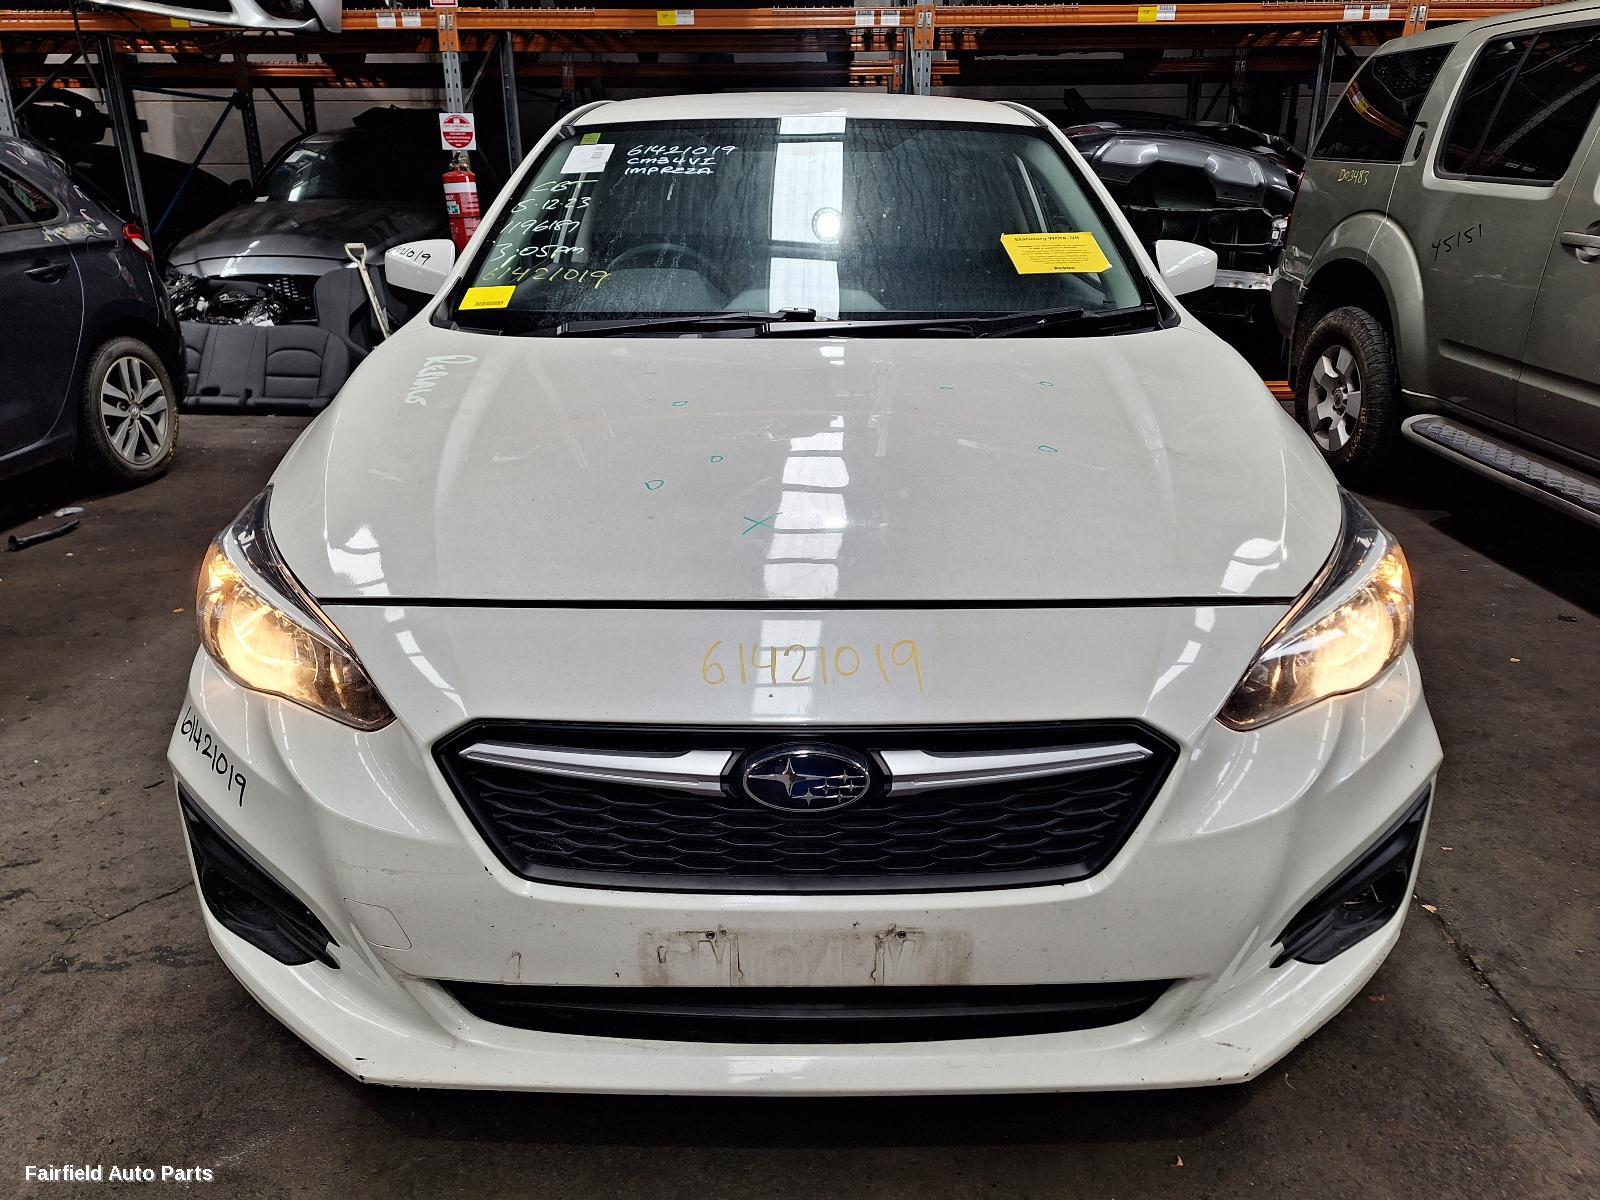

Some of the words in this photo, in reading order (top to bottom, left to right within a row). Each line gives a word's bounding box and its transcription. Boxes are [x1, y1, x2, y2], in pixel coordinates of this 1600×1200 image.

[627, 144, 738, 156] 61421019
[624, 165, 714, 175] IMPREZA
[1432, 223, 1482, 262] 45151
[482, 266, 612, 289] 61421019
[702, 639, 924, 693] 61421019
[180, 705, 246, 807] 61421019
